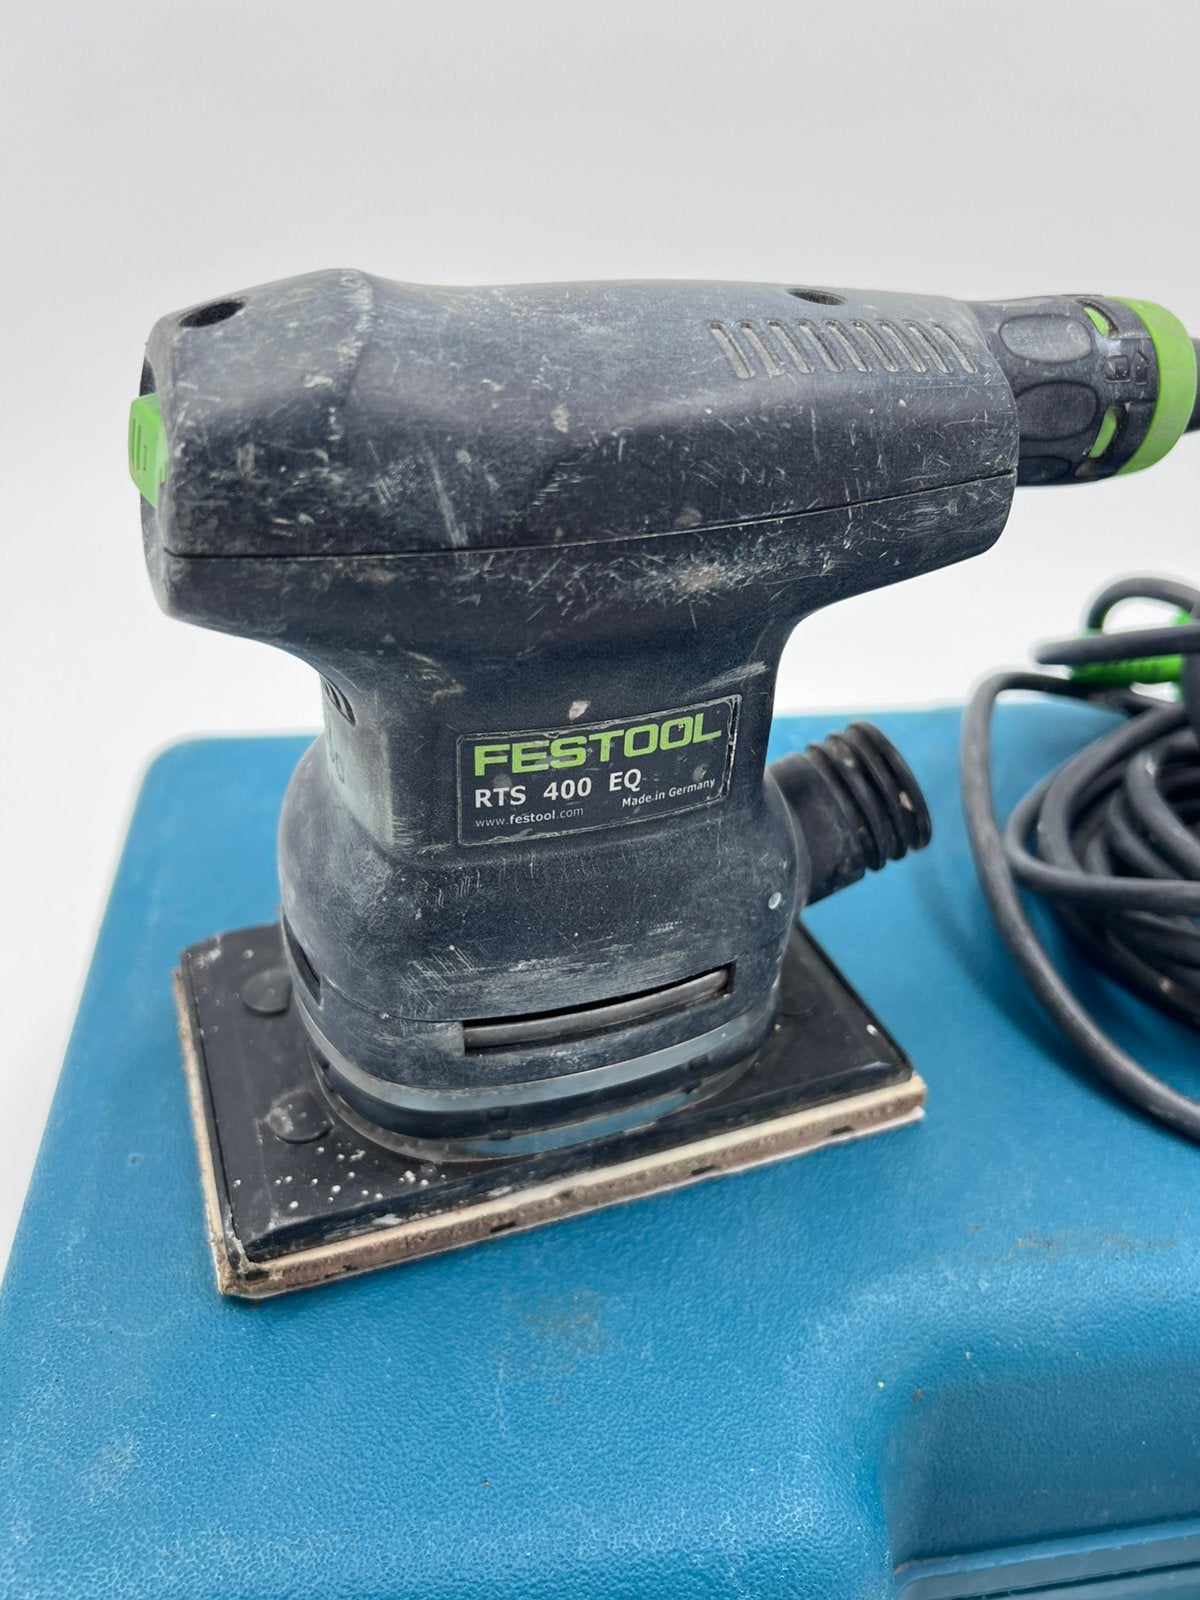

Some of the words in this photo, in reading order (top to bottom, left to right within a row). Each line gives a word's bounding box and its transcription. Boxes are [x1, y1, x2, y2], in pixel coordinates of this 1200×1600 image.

[474, 713, 722, 776] FESTOOL
[475, 785, 527, 808] RTS
[543, 777, 592, 801] 400
[609, 768, 642, 792] EQ
[622, 793, 652, 808] Made
[655, 790, 666, 801] in
[669, 778, 716, 798] Germany
[475, 806, 584, 828] www.festool.com
